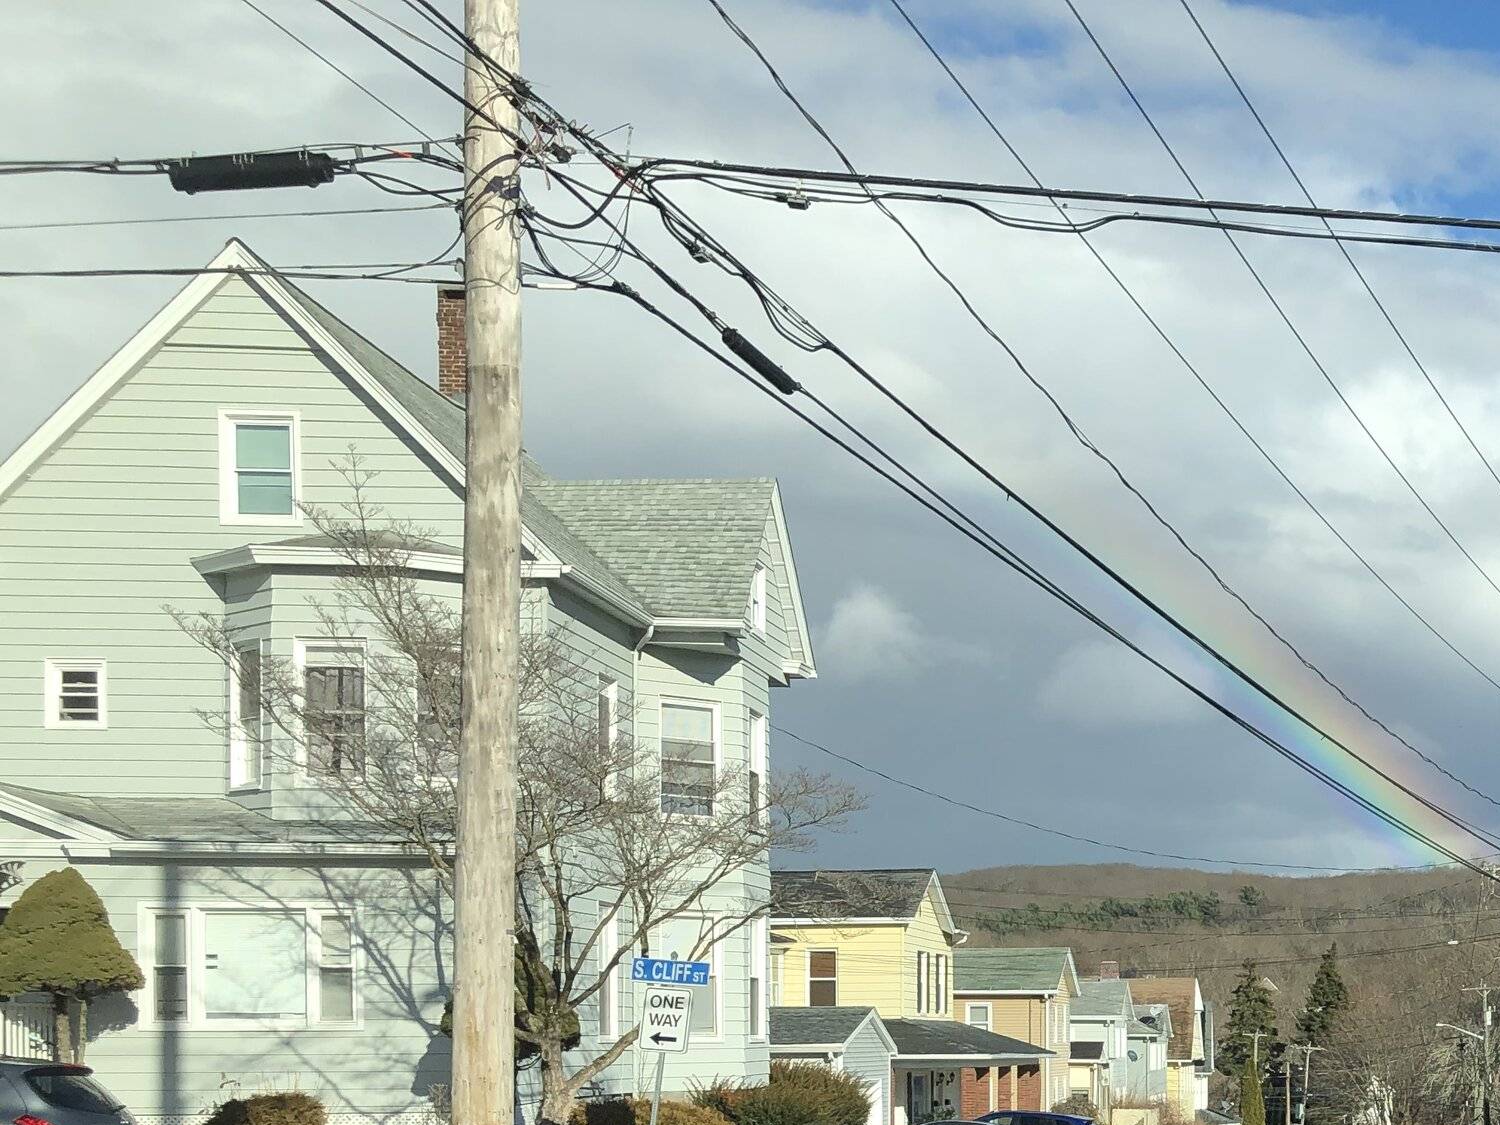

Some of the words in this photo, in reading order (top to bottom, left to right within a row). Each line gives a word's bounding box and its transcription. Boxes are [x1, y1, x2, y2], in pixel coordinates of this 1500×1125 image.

[634, 960, 648, 979] S.
[652, 962, 692, 981] CLIFF
[693, 972, 705, 983] ST
[650, 995, 685, 1009] ONE
[649, 1013, 682, 1027] WAY
